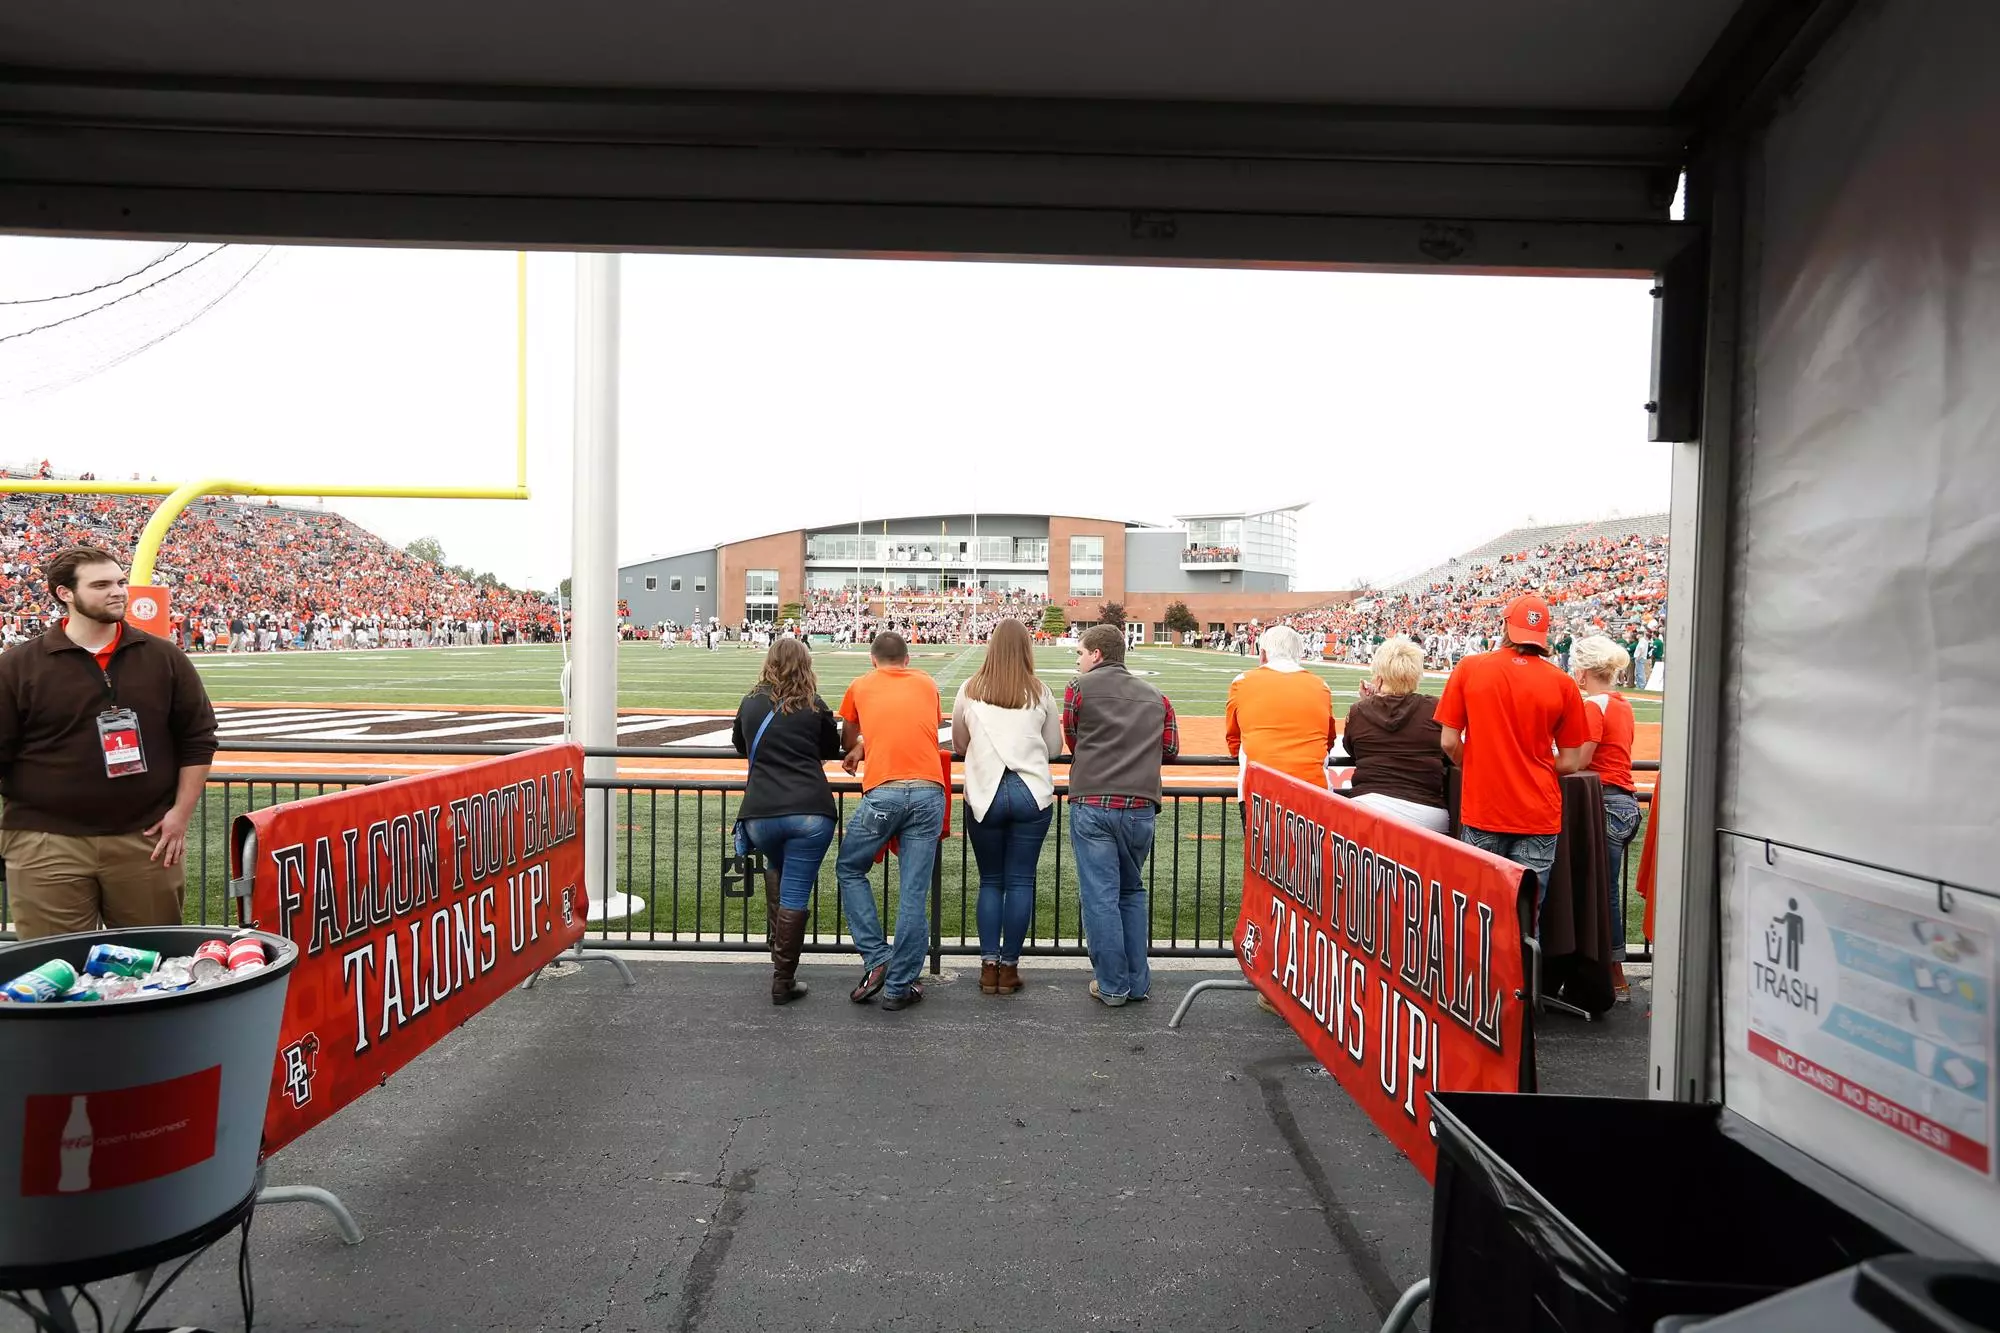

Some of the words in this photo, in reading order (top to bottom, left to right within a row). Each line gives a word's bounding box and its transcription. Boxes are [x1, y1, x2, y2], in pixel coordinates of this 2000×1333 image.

[115, 736, 123, 748] 1
[271, 804, 441, 954] FALCON
[449, 767, 578, 891] FOOTBALL
[343, 886, 497, 1052] TALONS
[508, 860, 551, 953] UP!
[1250, 791, 1325, 917] FALCON
[1330, 831, 1501, 1048] FOOTBALL
[1271, 896, 1366, 1061] TALONS
[1379, 979, 1438, 1138] UP!
[1753, 961, 1819, 1016] TRASH
[286, 1046, 310, 1103] BG
[1776, 1048, 1796, 1070] NO
[1797, 1061, 1840, 1094] CANS!
[1841, 1083, 1865, 1106] NO
[1866, 1095, 1949, 1149] BOTTLES!
[96, 1133, 128, 1147] open
